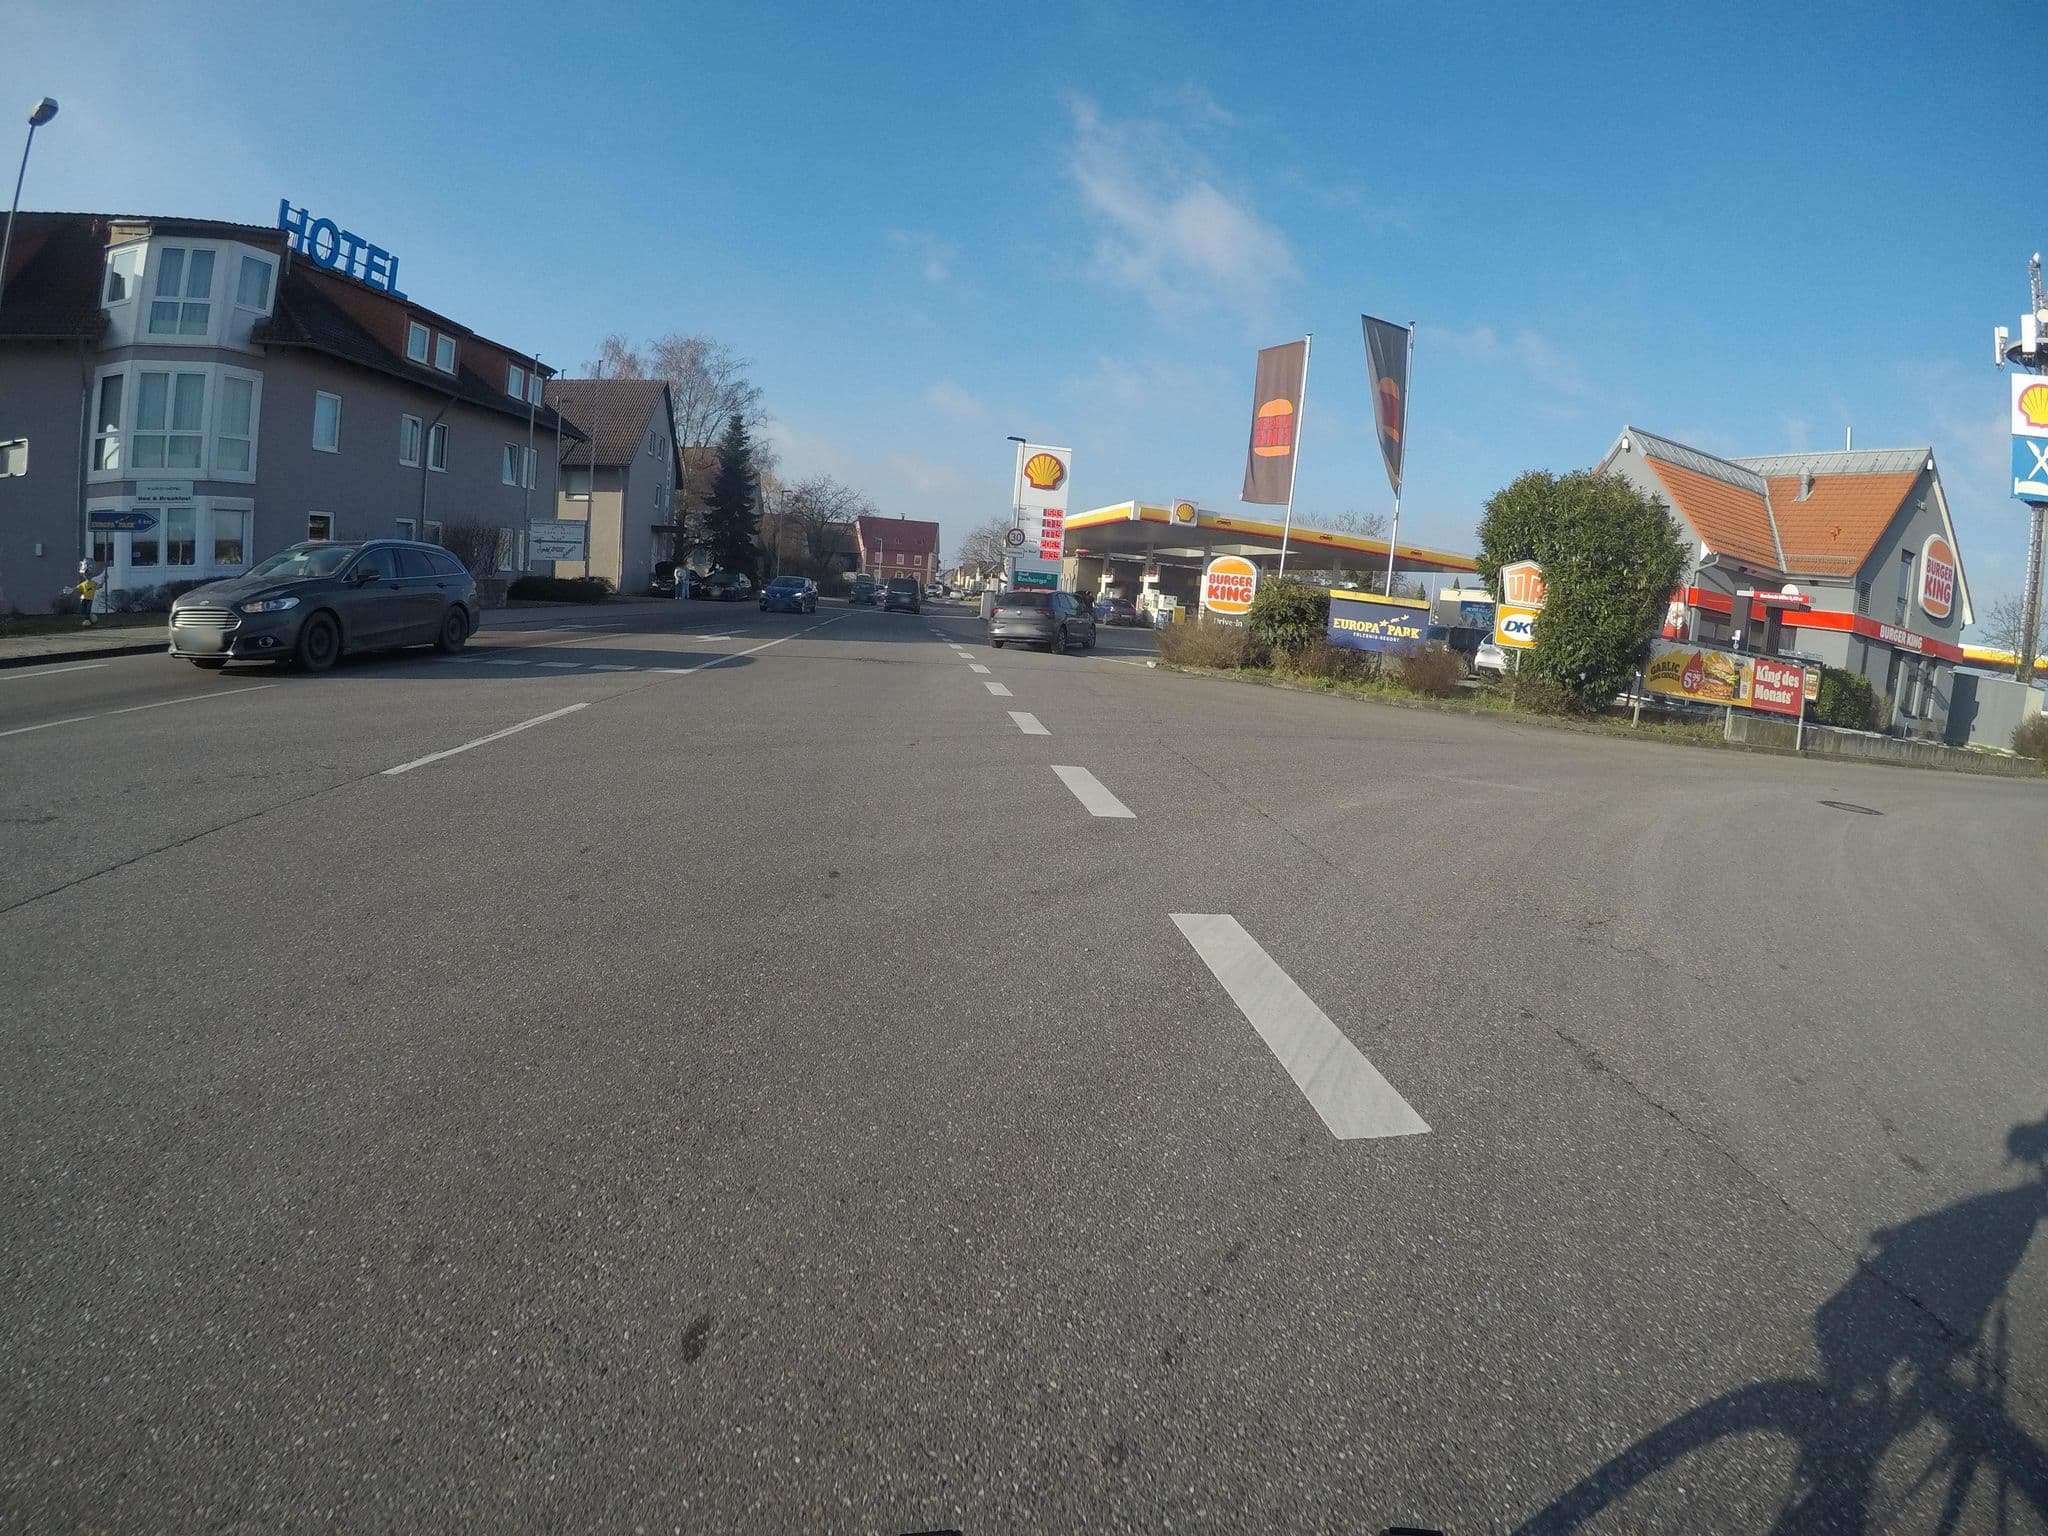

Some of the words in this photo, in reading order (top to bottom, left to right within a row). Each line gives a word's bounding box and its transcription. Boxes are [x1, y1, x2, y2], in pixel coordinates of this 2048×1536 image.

[279, 198, 408, 301] HOTEL
[1010, 533, 1022, 541] 30
[1208, 573, 1253, 588] BURGER
[1926, 559, 1953, 582] BURGER
[1207, 584, 1252, 603] KING
[1924, 575, 1952, 604] KING
[1333, 617, 1380, 634] EUROPA
[1387, 624, 1420, 640] PARK
[1880, 624, 1907, 645] BURGER
[1907, 633, 1923, 650] KING
[1650, 661, 1681, 675] GARLIC
[1756, 665, 1782, 688] King
[1782, 670, 1800, 688] des
